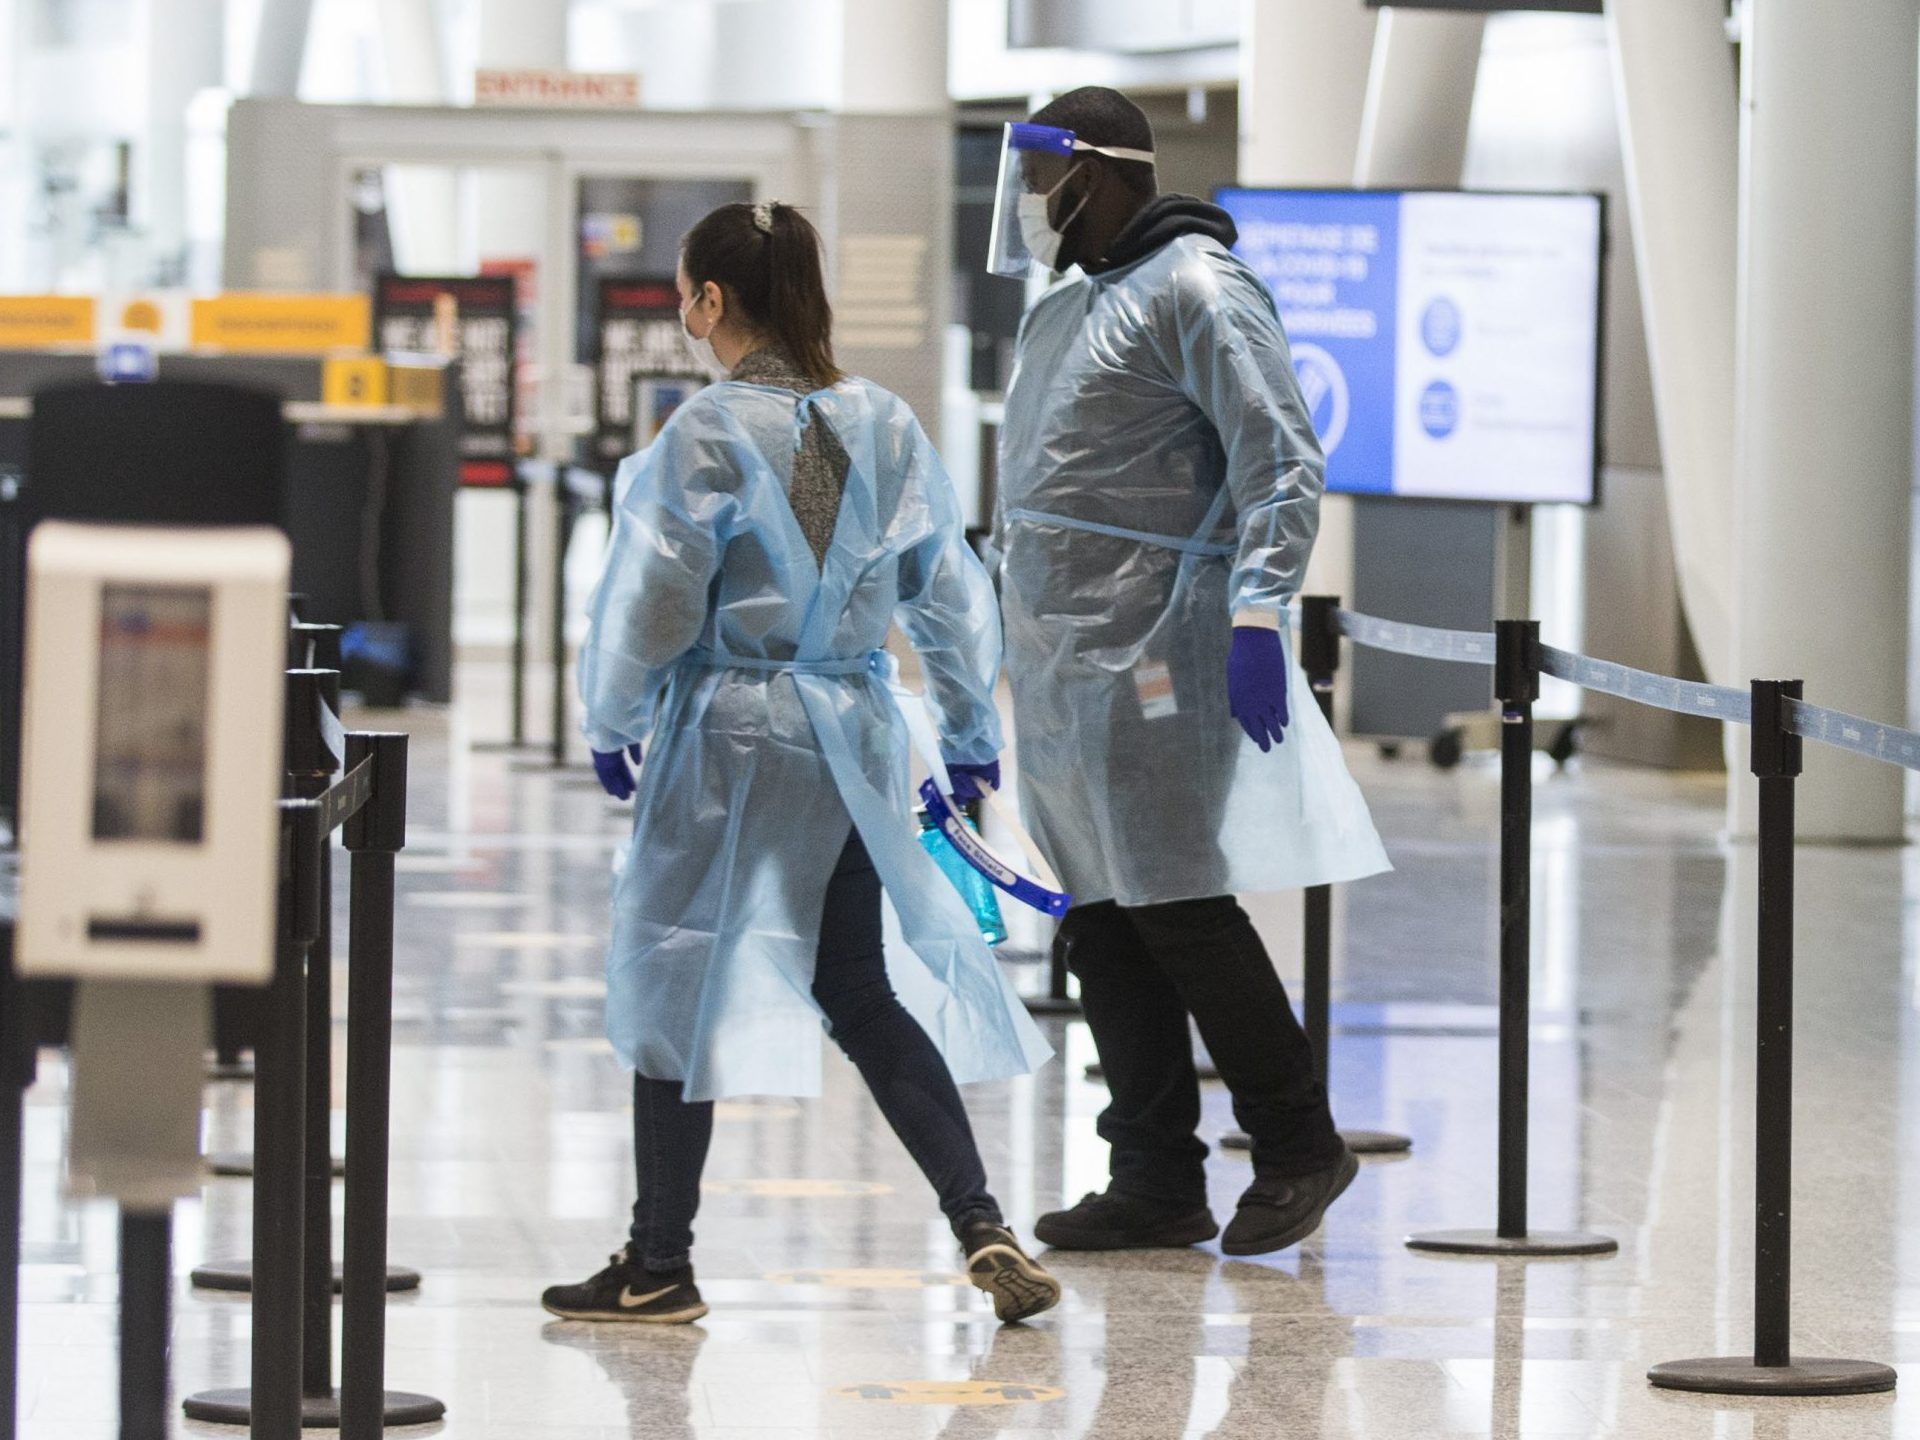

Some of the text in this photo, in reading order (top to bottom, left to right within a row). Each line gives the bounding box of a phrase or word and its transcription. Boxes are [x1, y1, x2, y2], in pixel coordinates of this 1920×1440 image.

[476, 74, 638, 98] ENTRANCE
[954, 828, 1003, 877] Face Shield
